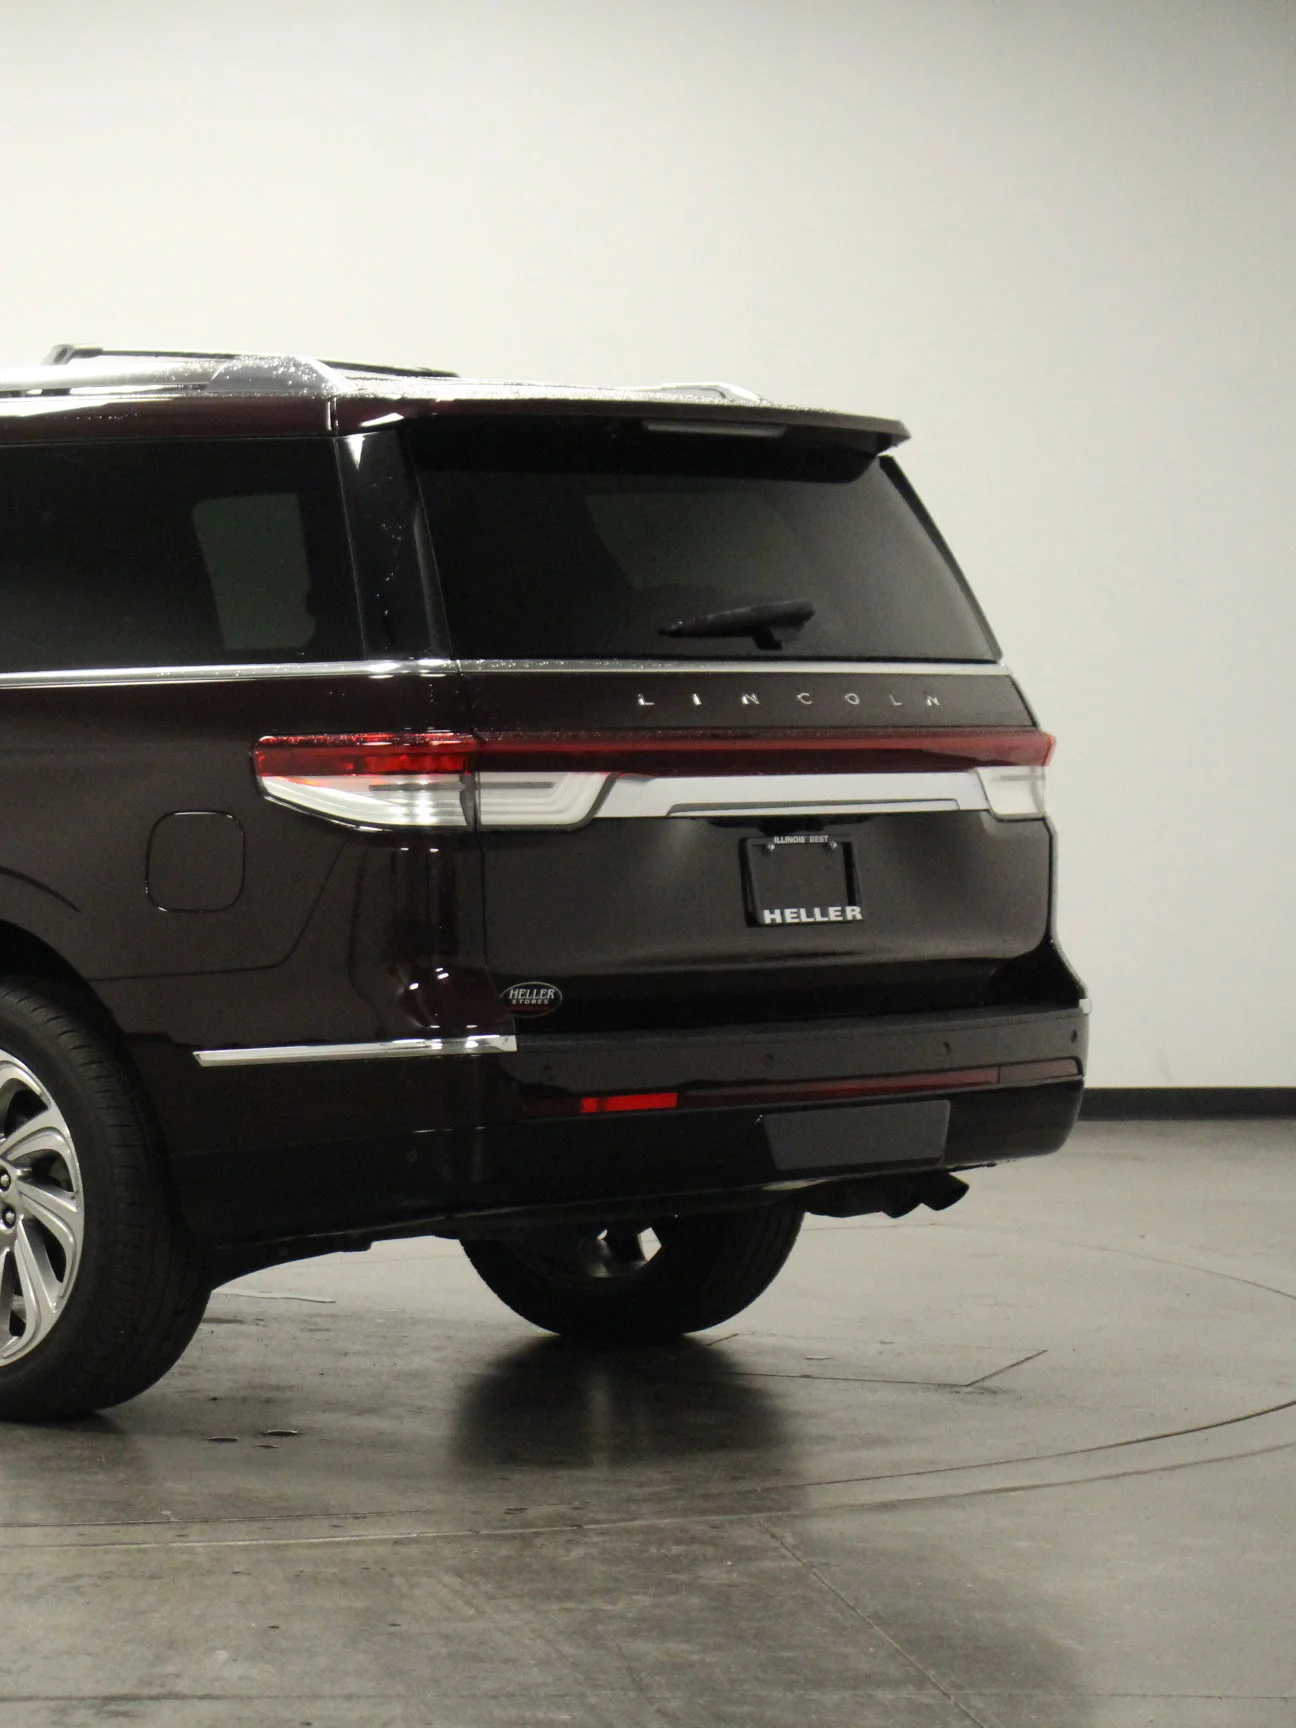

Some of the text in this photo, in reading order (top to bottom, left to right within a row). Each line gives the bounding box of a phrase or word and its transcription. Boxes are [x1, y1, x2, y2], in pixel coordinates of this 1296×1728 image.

[637, 692, 940, 707] LINCOLN
[809, 834, 829, 843] BEST
[763, 906, 863, 924] HELLER
[509, 988, 555, 999] HELLER
